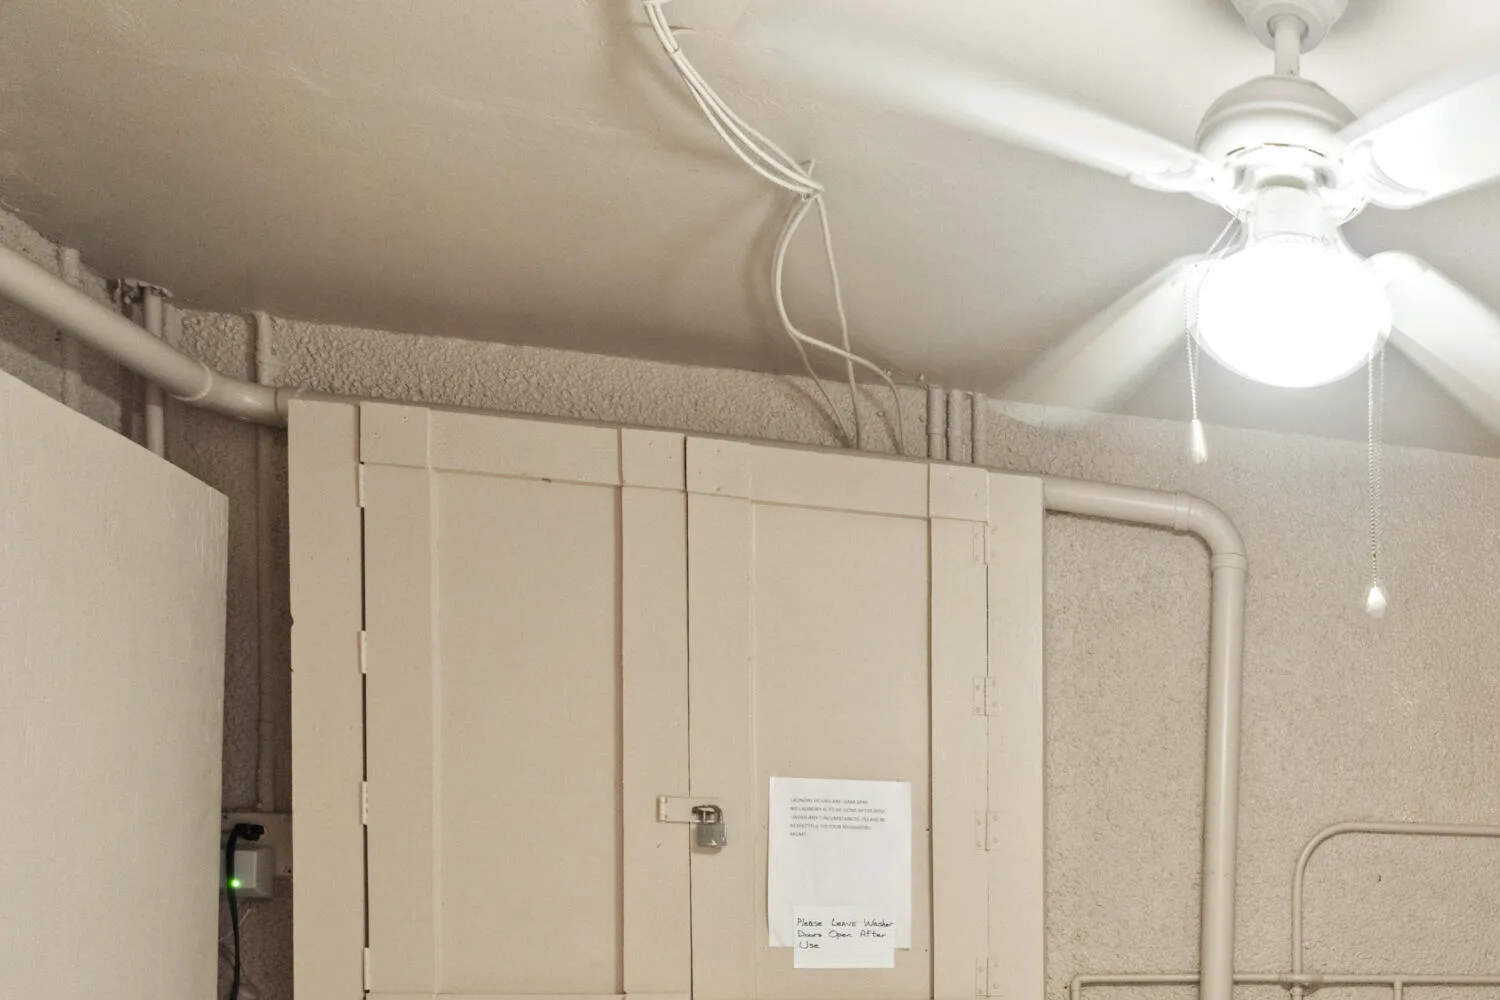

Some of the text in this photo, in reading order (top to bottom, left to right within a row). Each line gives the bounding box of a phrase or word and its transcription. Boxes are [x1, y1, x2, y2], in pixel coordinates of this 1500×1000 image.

[797, 918, 822, 926] Please
[864, 918, 893, 927] Washer
[828, 930, 853, 940] Open
[799, 941, 820, 949] Use
